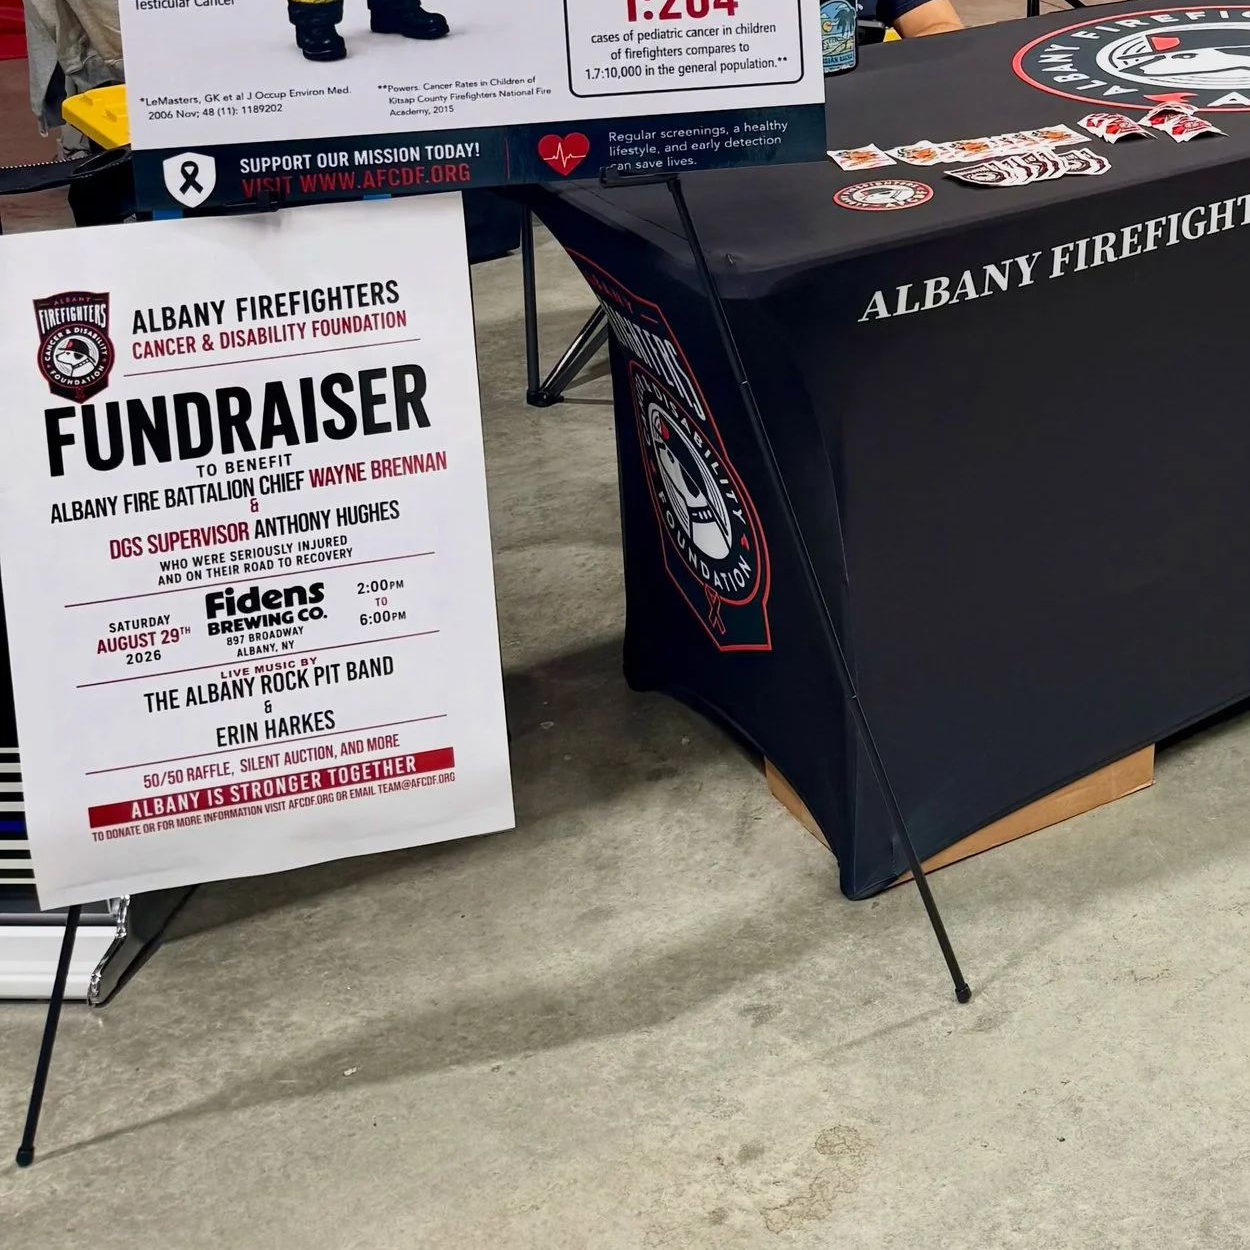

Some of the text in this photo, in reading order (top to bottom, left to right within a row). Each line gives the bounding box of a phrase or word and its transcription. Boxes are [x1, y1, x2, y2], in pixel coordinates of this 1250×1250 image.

[1038, 43, 1139, 96] ALBANY
[240, 142, 479, 173] SUPPORT OUR MISSION TODAY!
[299, 163, 471, 192] WWW.AFCDF.ORG
[856, 251, 1044, 323] ALBANY
[133, 279, 399, 334] ALBANY FIREFIGHTERS
[44, 363, 432, 477] FUNDRAISER
[196, 453, 292, 478] TO BENEFIT
[309, 451, 447, 488] WAYNE BRENNAN
[110, 500, 399, 559] DGS SUPERVISOR ANTHONY HUGHES
[204, 581, 325, 619] Fidens
[109, 615, 170, 633] SATURDAY
[207, 607, 327, 636] BREWING CO.
[126, 650, 161, 665] 2026
[144, 656, 393, 713] THE ALBANY ROCK PIT BAND
[216, 710, 335, 747] ERIN HARKES
[132, 756, 416, 820] ALBANY IS STRONGER TOGETHER
